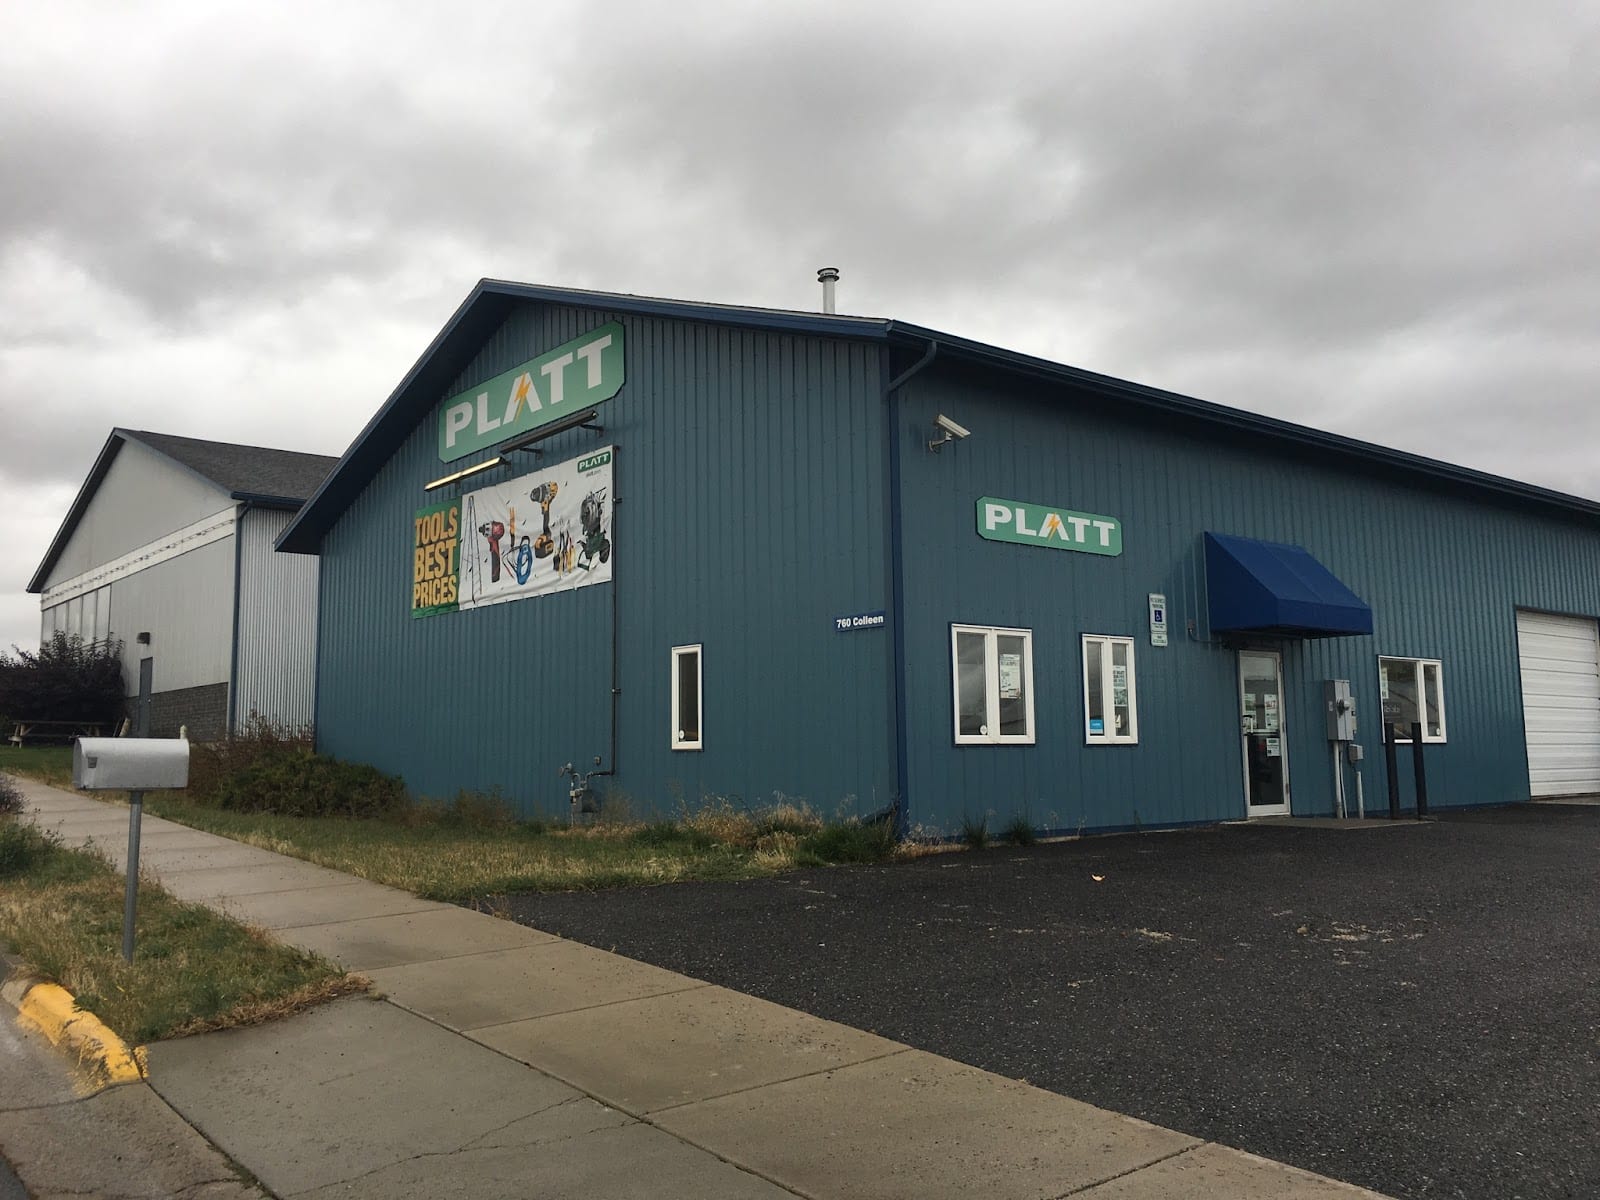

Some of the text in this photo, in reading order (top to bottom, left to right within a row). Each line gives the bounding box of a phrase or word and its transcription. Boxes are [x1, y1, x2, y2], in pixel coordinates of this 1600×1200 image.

[446, 334, 612, 448] PLATT
[579, 453, 609, 470] PLATT
[415, 507, 458, 546] TOOLS
[985, 503, 1115, 546] PLATT
[414, 538, 457, 582] BEST
[412, 575, 457, 609] PRICES
[836, 616, 884, 628] 760 Colleen
